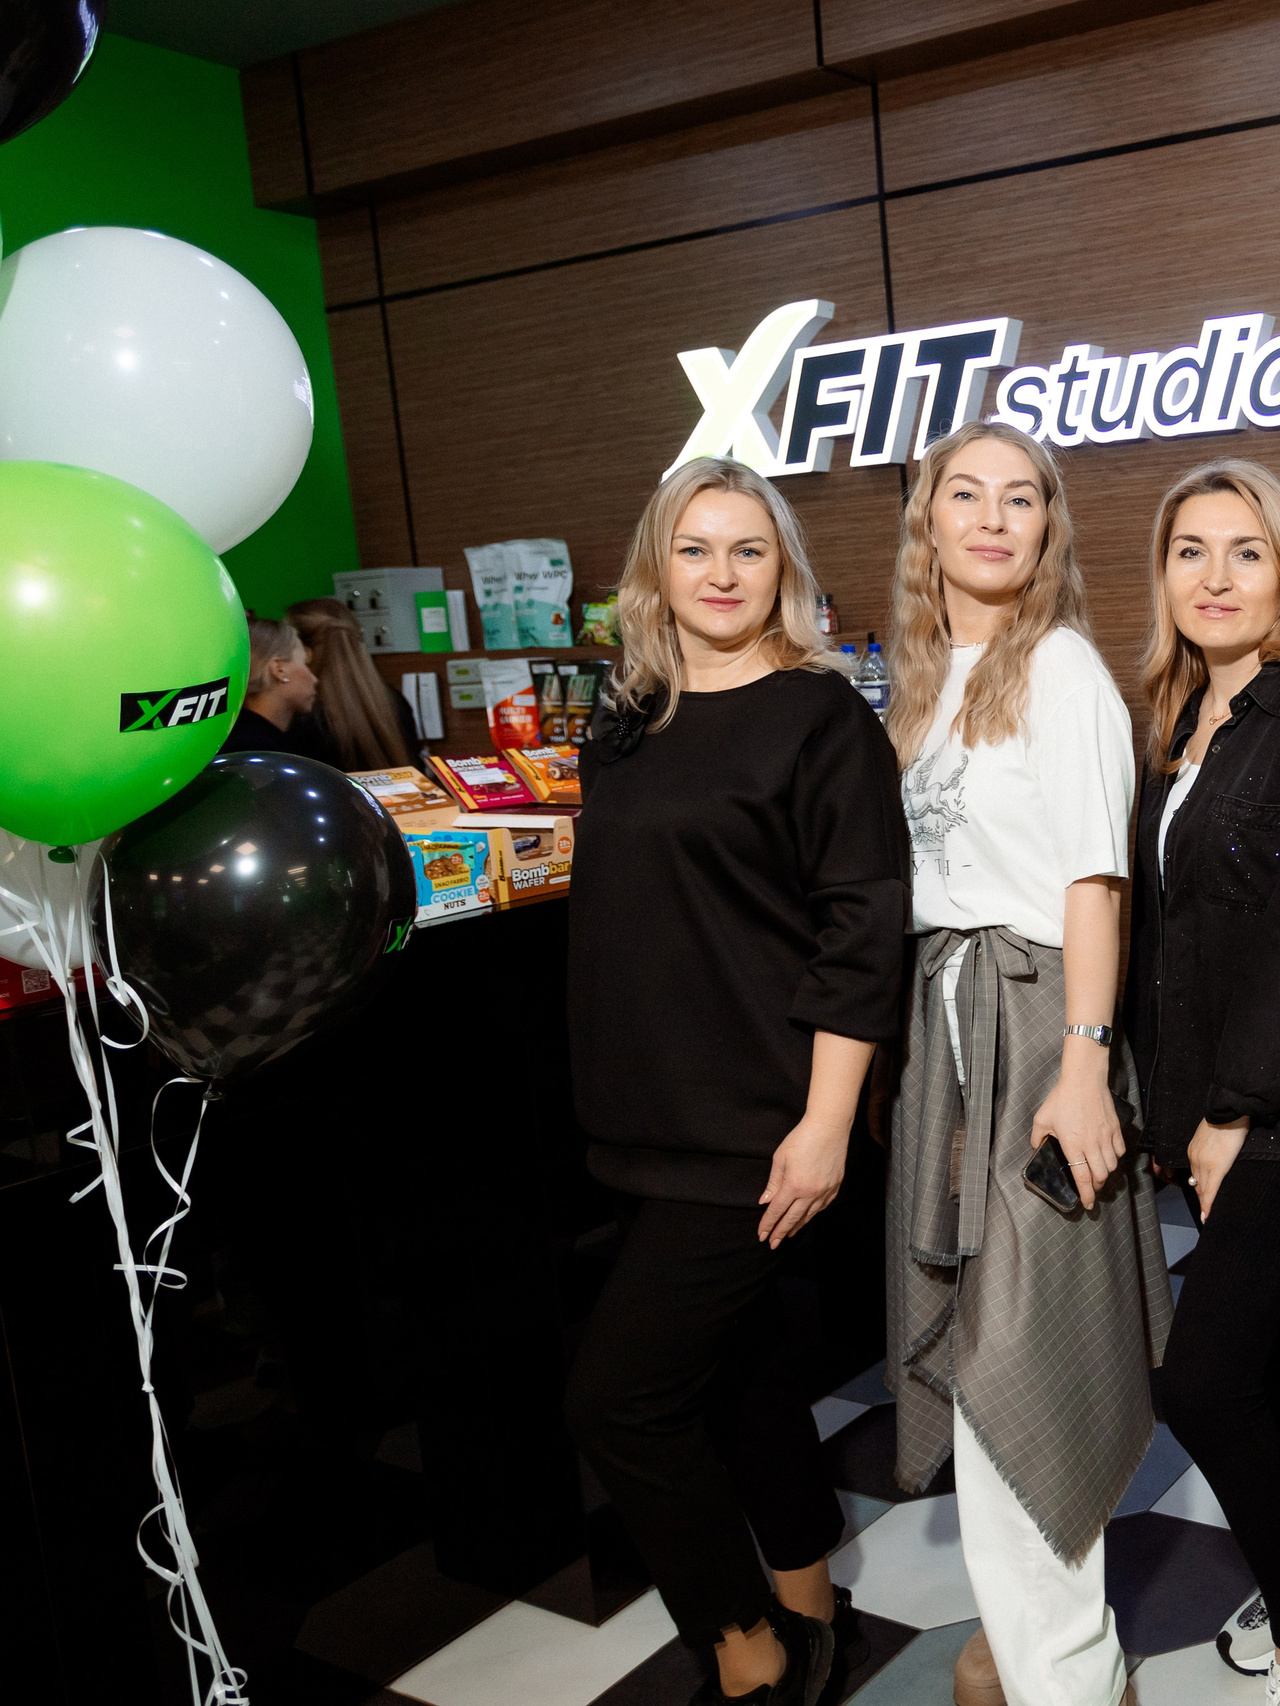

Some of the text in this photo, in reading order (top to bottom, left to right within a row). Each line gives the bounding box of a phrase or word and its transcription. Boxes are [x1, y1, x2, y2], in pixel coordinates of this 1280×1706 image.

[662, 299, 1020, 481] XFIT
[122, 687, 228, 731] XFIT
[446, 756, 499, 768] Bombbar
[512, 861, 570, 882] Bombbar
[513, 877, 545, 890] WAFER
[432, 886, 474, 903] COOKIE
[443, 899, 466, 910] NUTS
